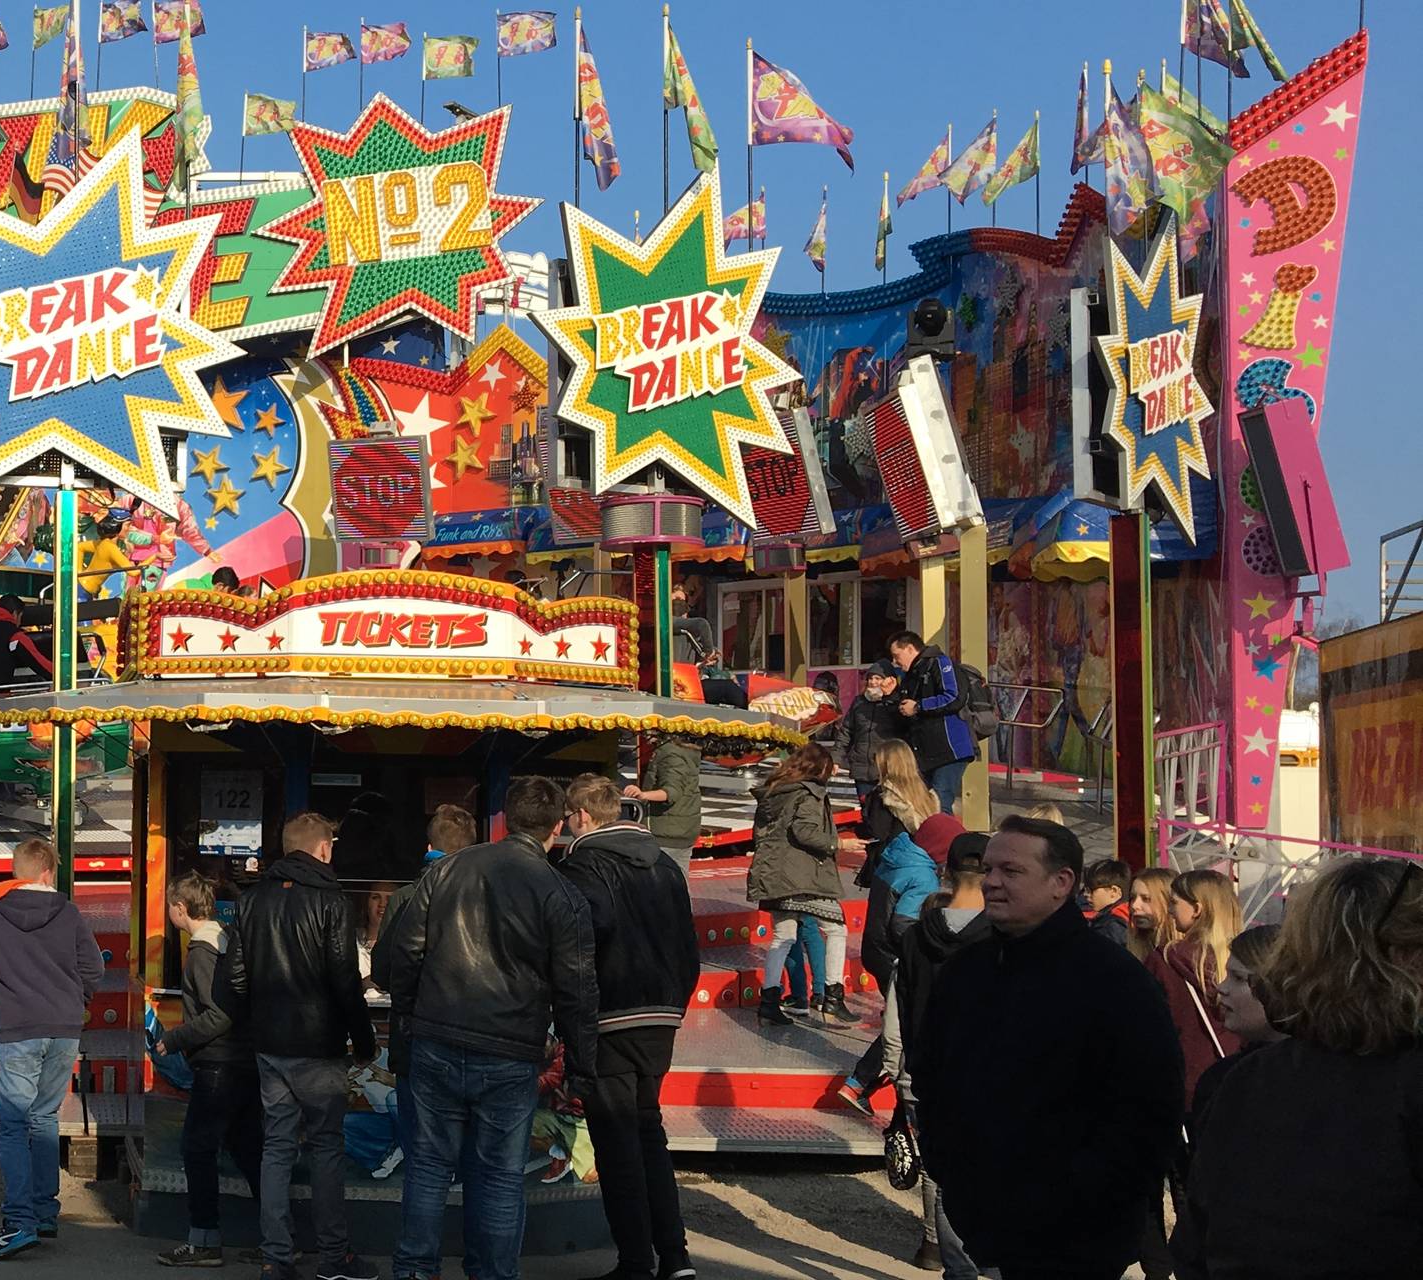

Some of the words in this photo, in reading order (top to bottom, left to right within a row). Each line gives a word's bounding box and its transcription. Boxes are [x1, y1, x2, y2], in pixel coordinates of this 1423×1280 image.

[432, 160, 493, 253] 2
[5, 314, 160, 399] DANCE
[597, 294, 720, 366] BREAK
[626, 336, 744, 408] DANCE
[1129, 333, 1183, 389] BREAK
[1142, 372, 1194, 431] DANCE
[340, 473, 415, 509] STOP
[435, 527, 460, 543] Funk
[460, 523, 481, 539] and
[317, 611, 488, 649] TICKETS
[214, 789, 251, 809] 122
